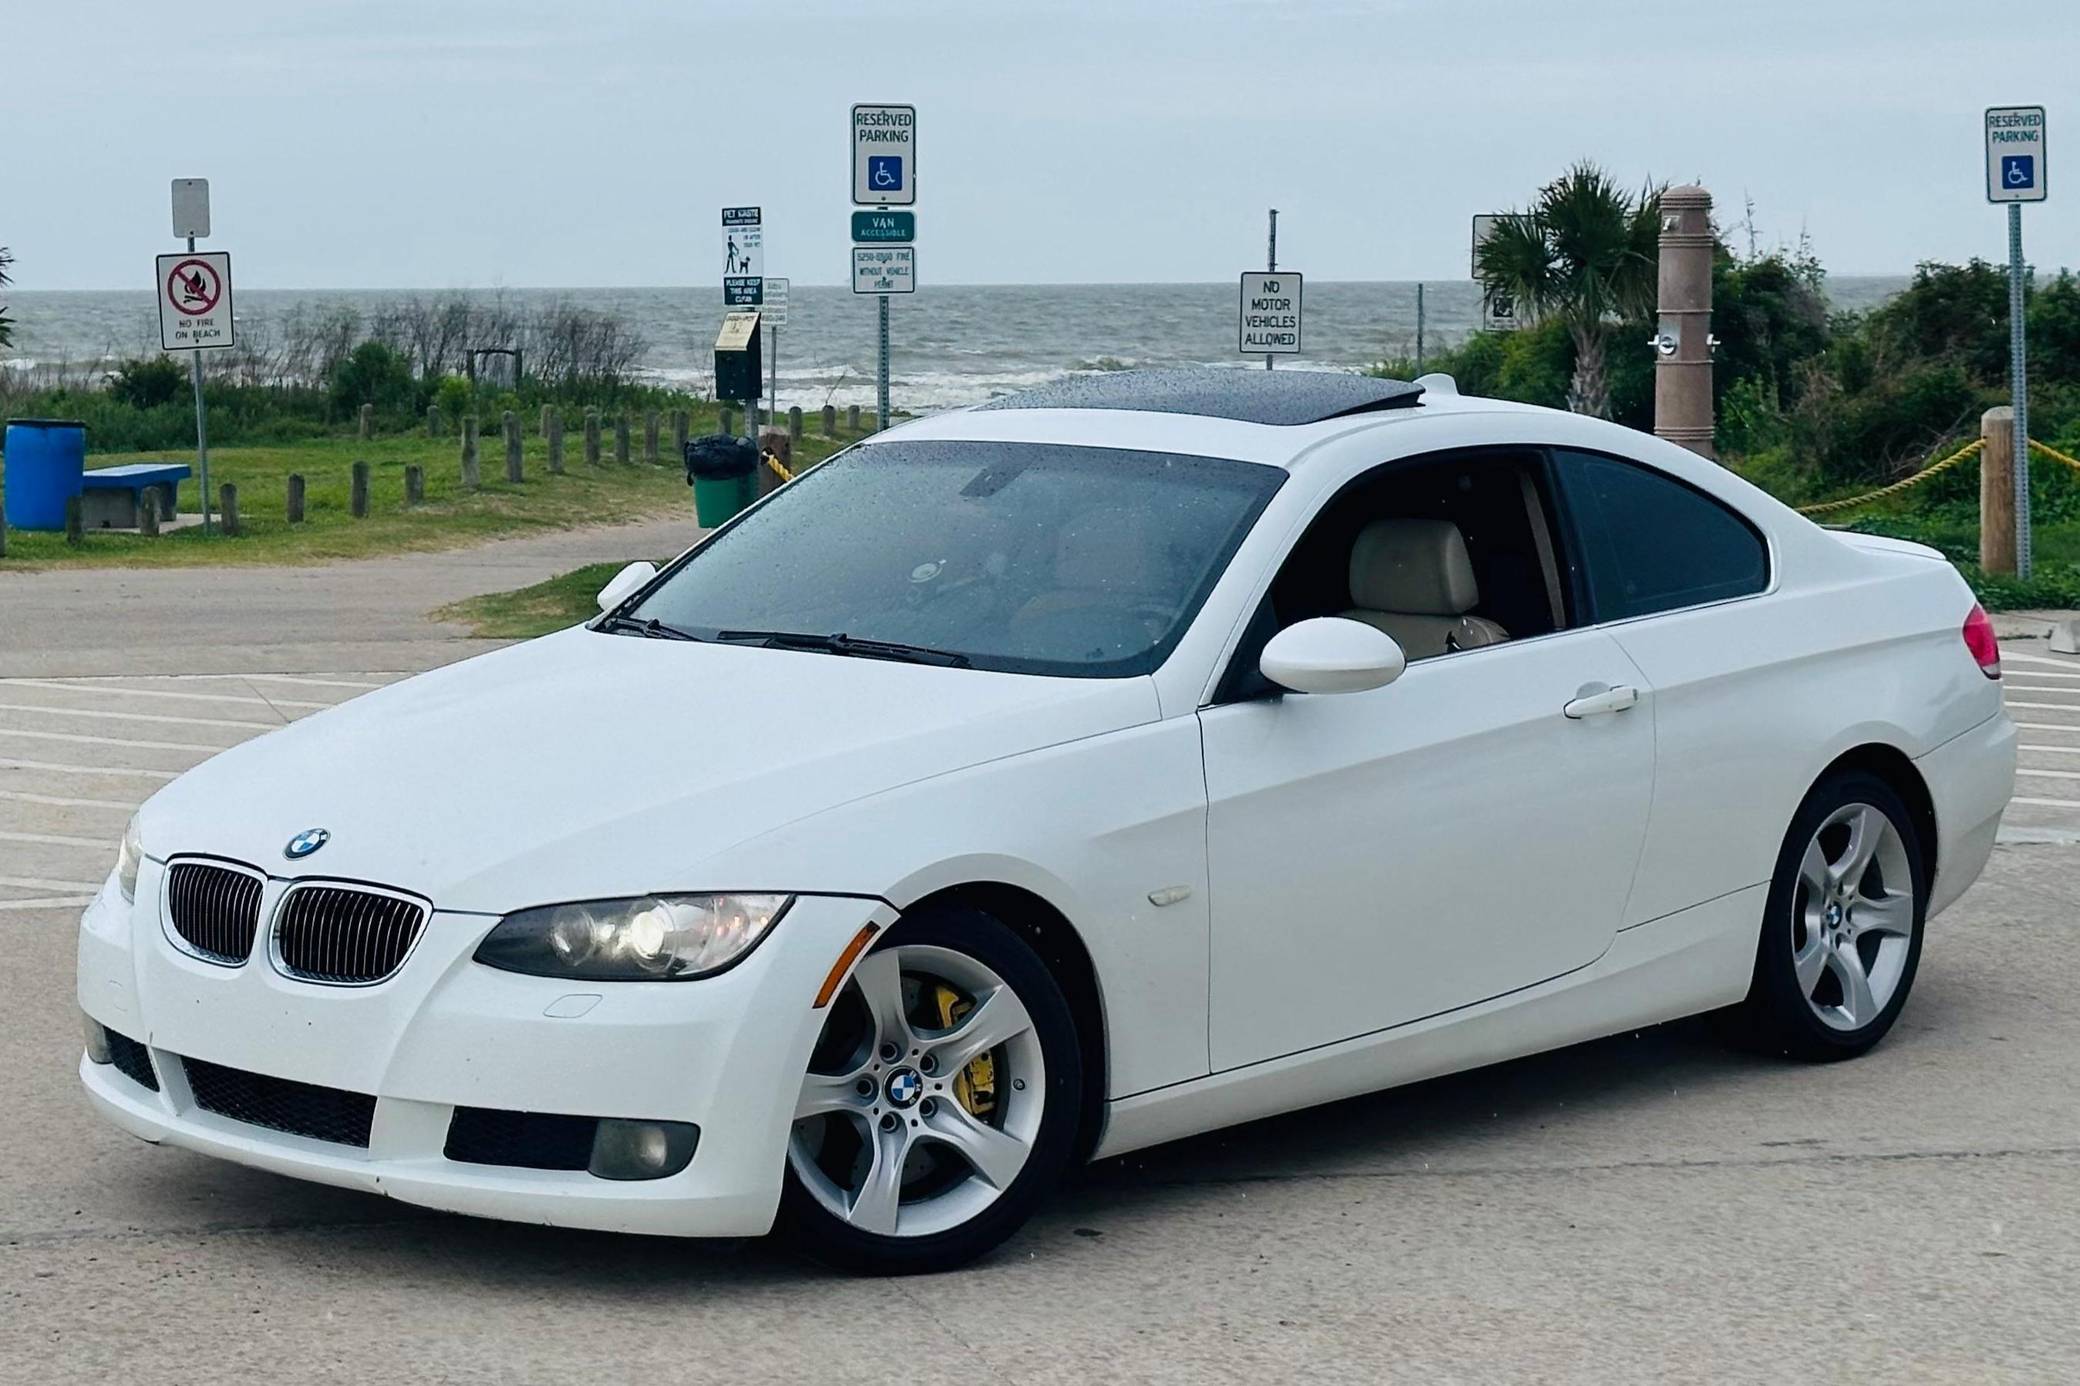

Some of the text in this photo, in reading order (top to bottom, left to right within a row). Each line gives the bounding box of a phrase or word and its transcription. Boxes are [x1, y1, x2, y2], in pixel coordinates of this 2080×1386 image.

[856, 112, 912, 126] RESERVED
[1989, 114, 2041, 128] RESERVED
[859, 129, 909, 142] PARKING
[1992, 130, 2039, 143] PARKING
[872, 217, 894, 229] VAN
[861, 229, 906, 237] ACCESSIBLE
[726, 279, 745, 287] PLEASE
[1263, 280, 1280, 294] NO
[1251, 298, 1291, 311] MOTOR
[179, 319, 215, 328] NO FIRE
[1245, 315, 1296, 328] VEHICLES
[175, 329, 221, 339] ON BEACH
[1244, 332, 1296, 346] ALLOWED
